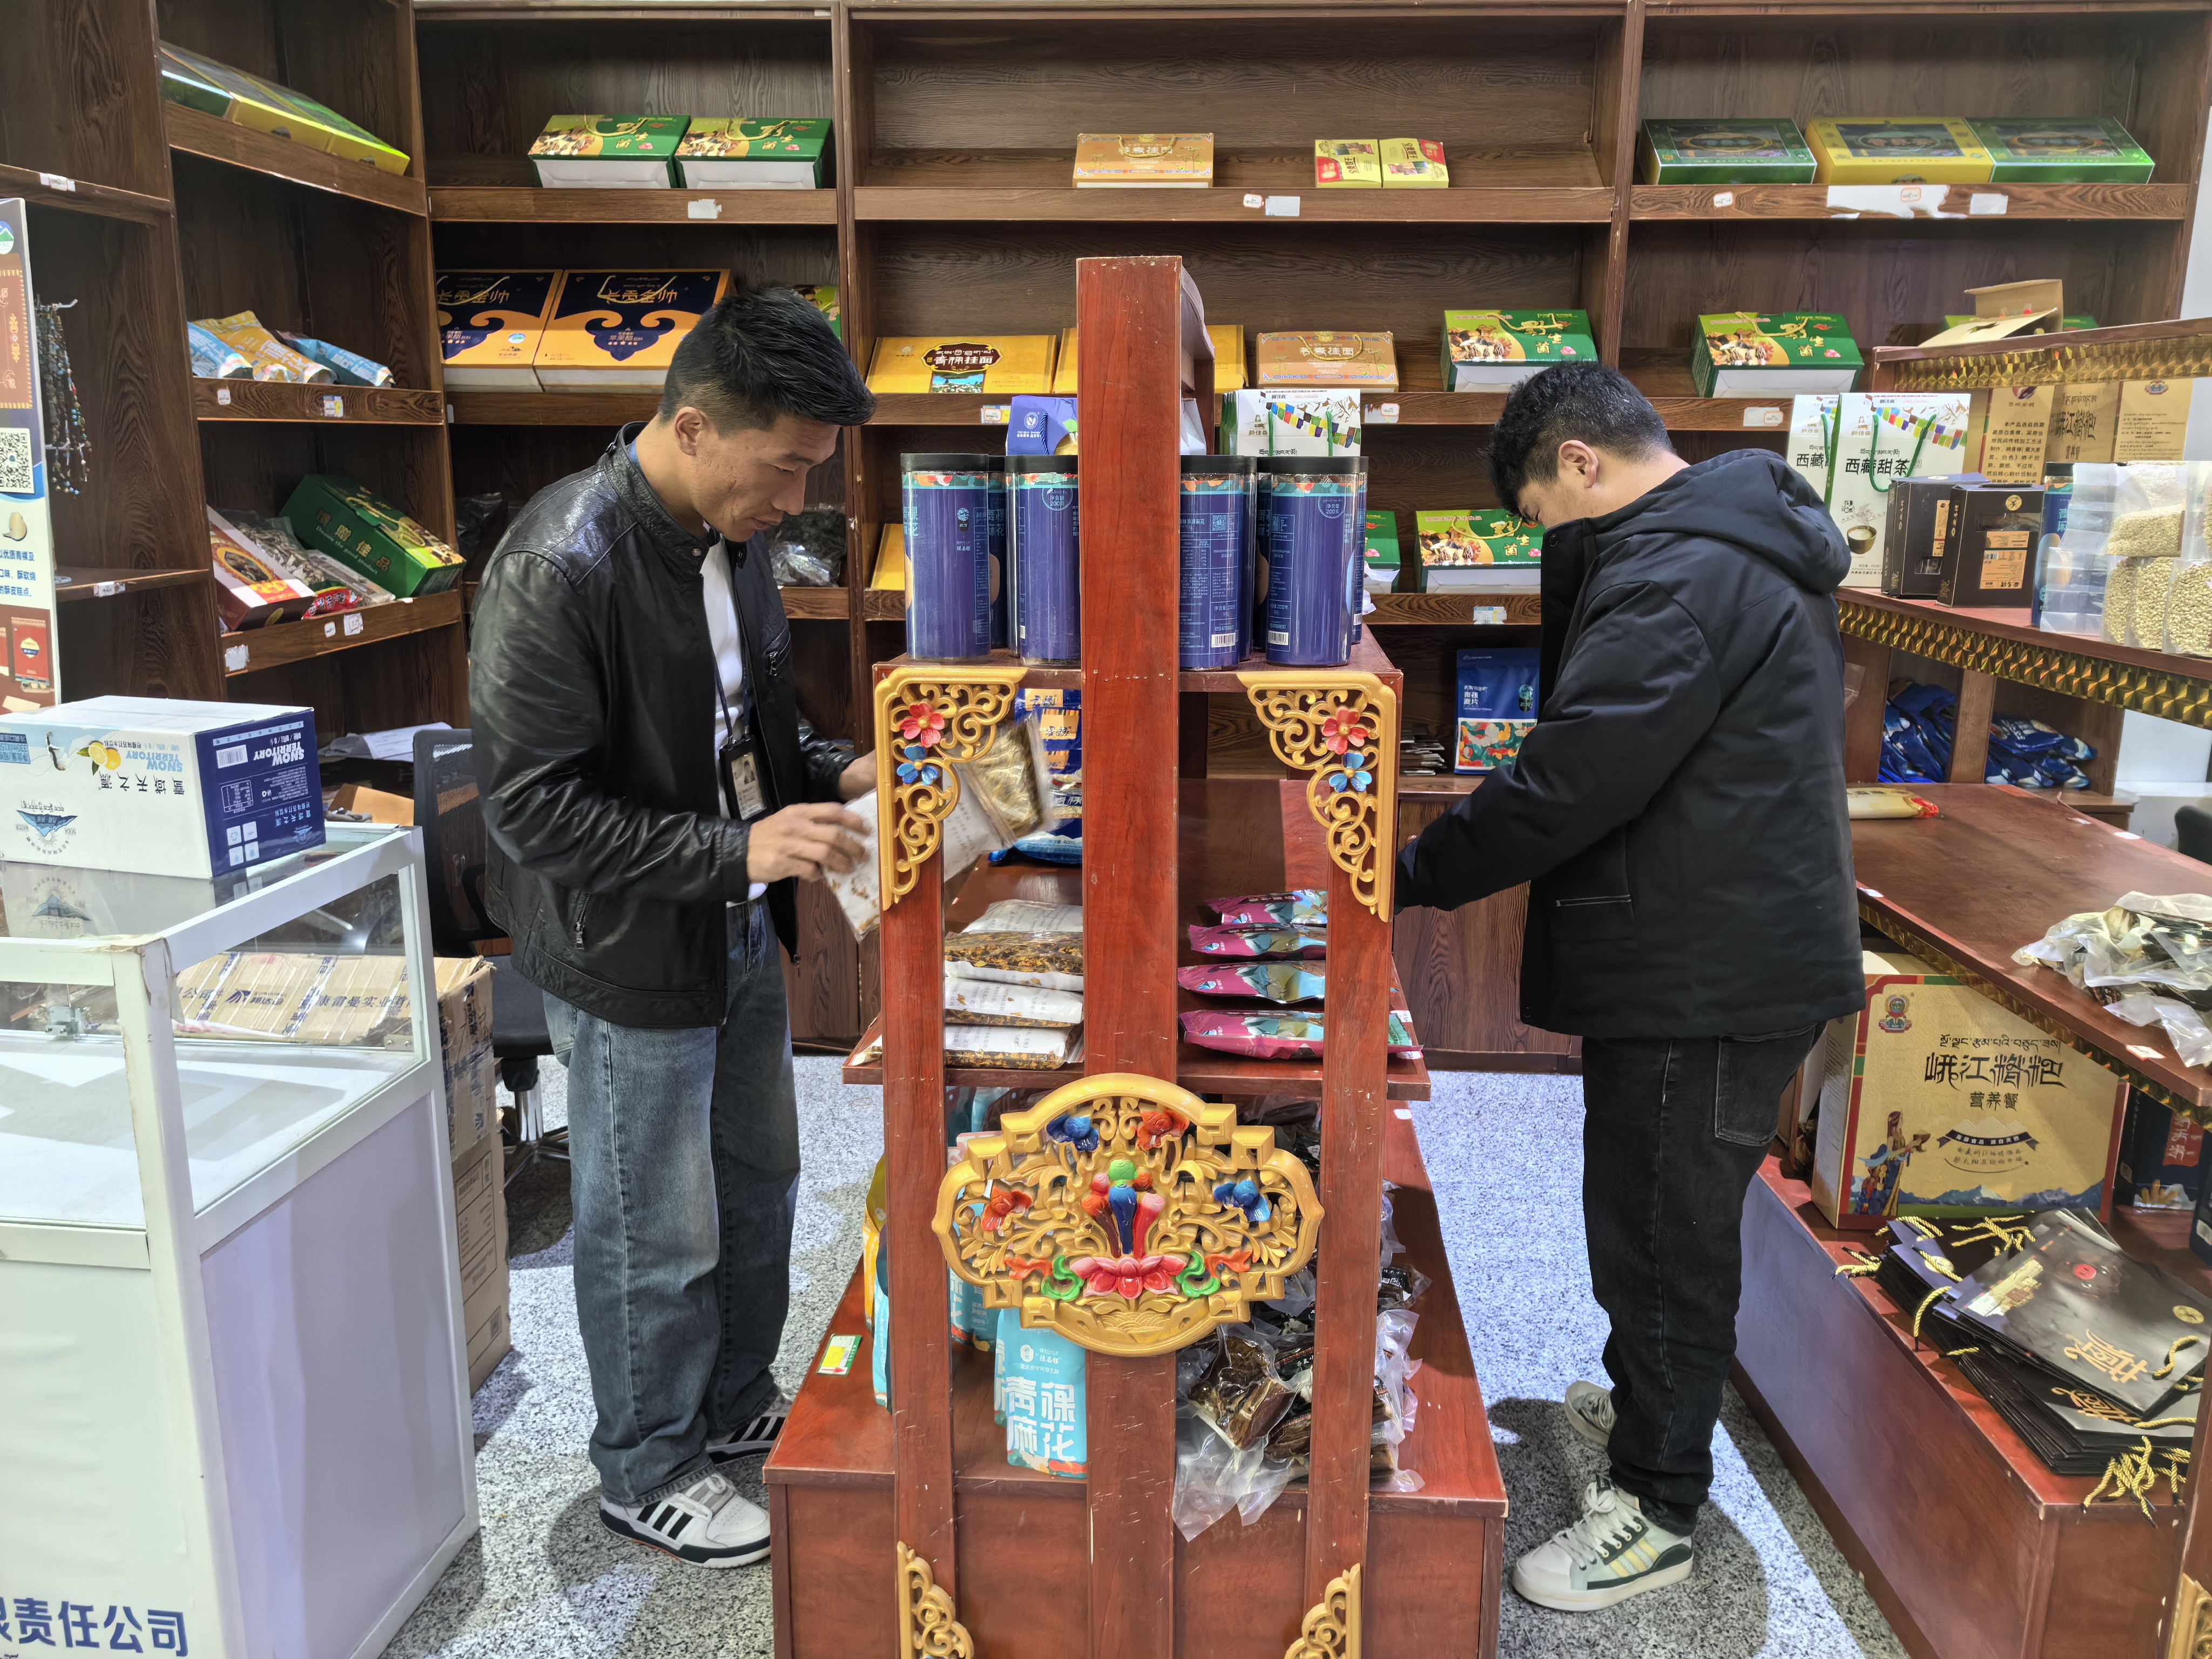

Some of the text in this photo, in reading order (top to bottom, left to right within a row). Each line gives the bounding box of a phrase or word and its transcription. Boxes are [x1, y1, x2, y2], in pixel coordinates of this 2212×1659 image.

[1796, 453, 1830, 469] 西藏
[1845, 458, 1911, 476] 西藏甜茶
[126, 750, 181, 763] TERRITORY
[253, 741, 302, 760] TERRITORY
[272, 748, 305, 767] SNOW
[146, 759, 183, 772] SNOW
[1006, 1375, 1076, 1422] 青稞
[1007, 1415, 1077, 1462] 麻花
[0, 1596, 188, 1657] 责任公司
